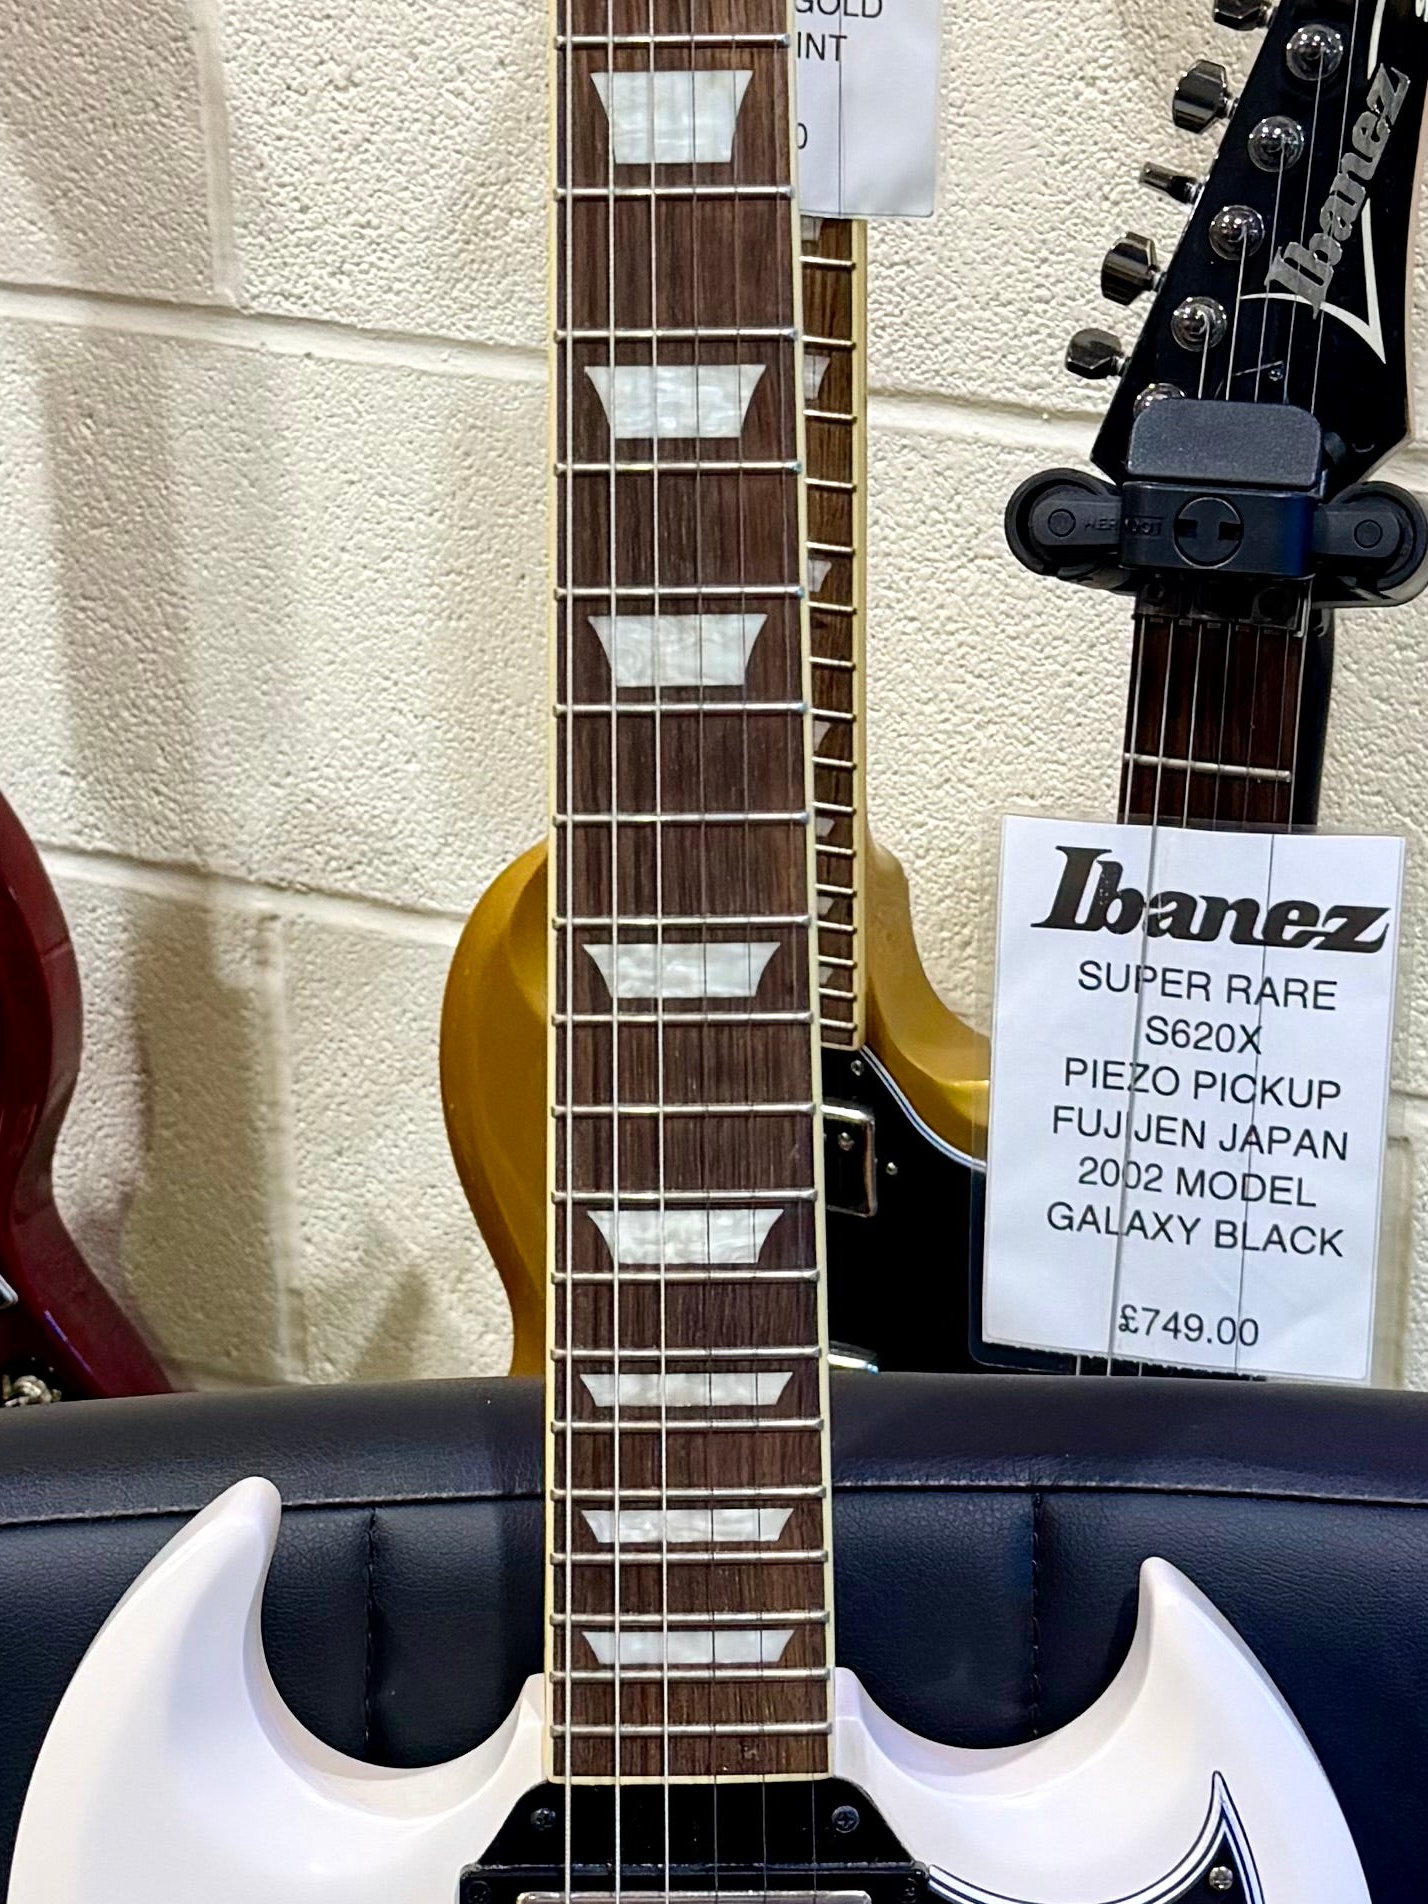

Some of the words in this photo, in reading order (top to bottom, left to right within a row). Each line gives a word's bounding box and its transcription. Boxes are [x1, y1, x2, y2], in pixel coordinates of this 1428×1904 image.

[797, 31, 848, 62] INT
[1263, 62, 1411, 320] Ibanez
[1030, 845, 1391, 954] Ibanez
[1078, 960, 1211, 1002] SUPER
[1227, 974, 1338, 1011] RARE
[1145, 1016, 1262, 1054] S620X
[1065, 1057, 1180, 1096] PIEZO
[1194, 1069, 1342, 1110] PICKUP
[1219, 1124, 1348, 1160] JAPAN
[1078, 1157, 1162, 1192] 2002
[1176, 1167, 1317, 1207] MODEL
[1047, 1204, 1201, 1245] GALAXY
[1215, 1221, 1344, 1257] BLACK
[1118, 1305, 1259, 1347] £749.00
